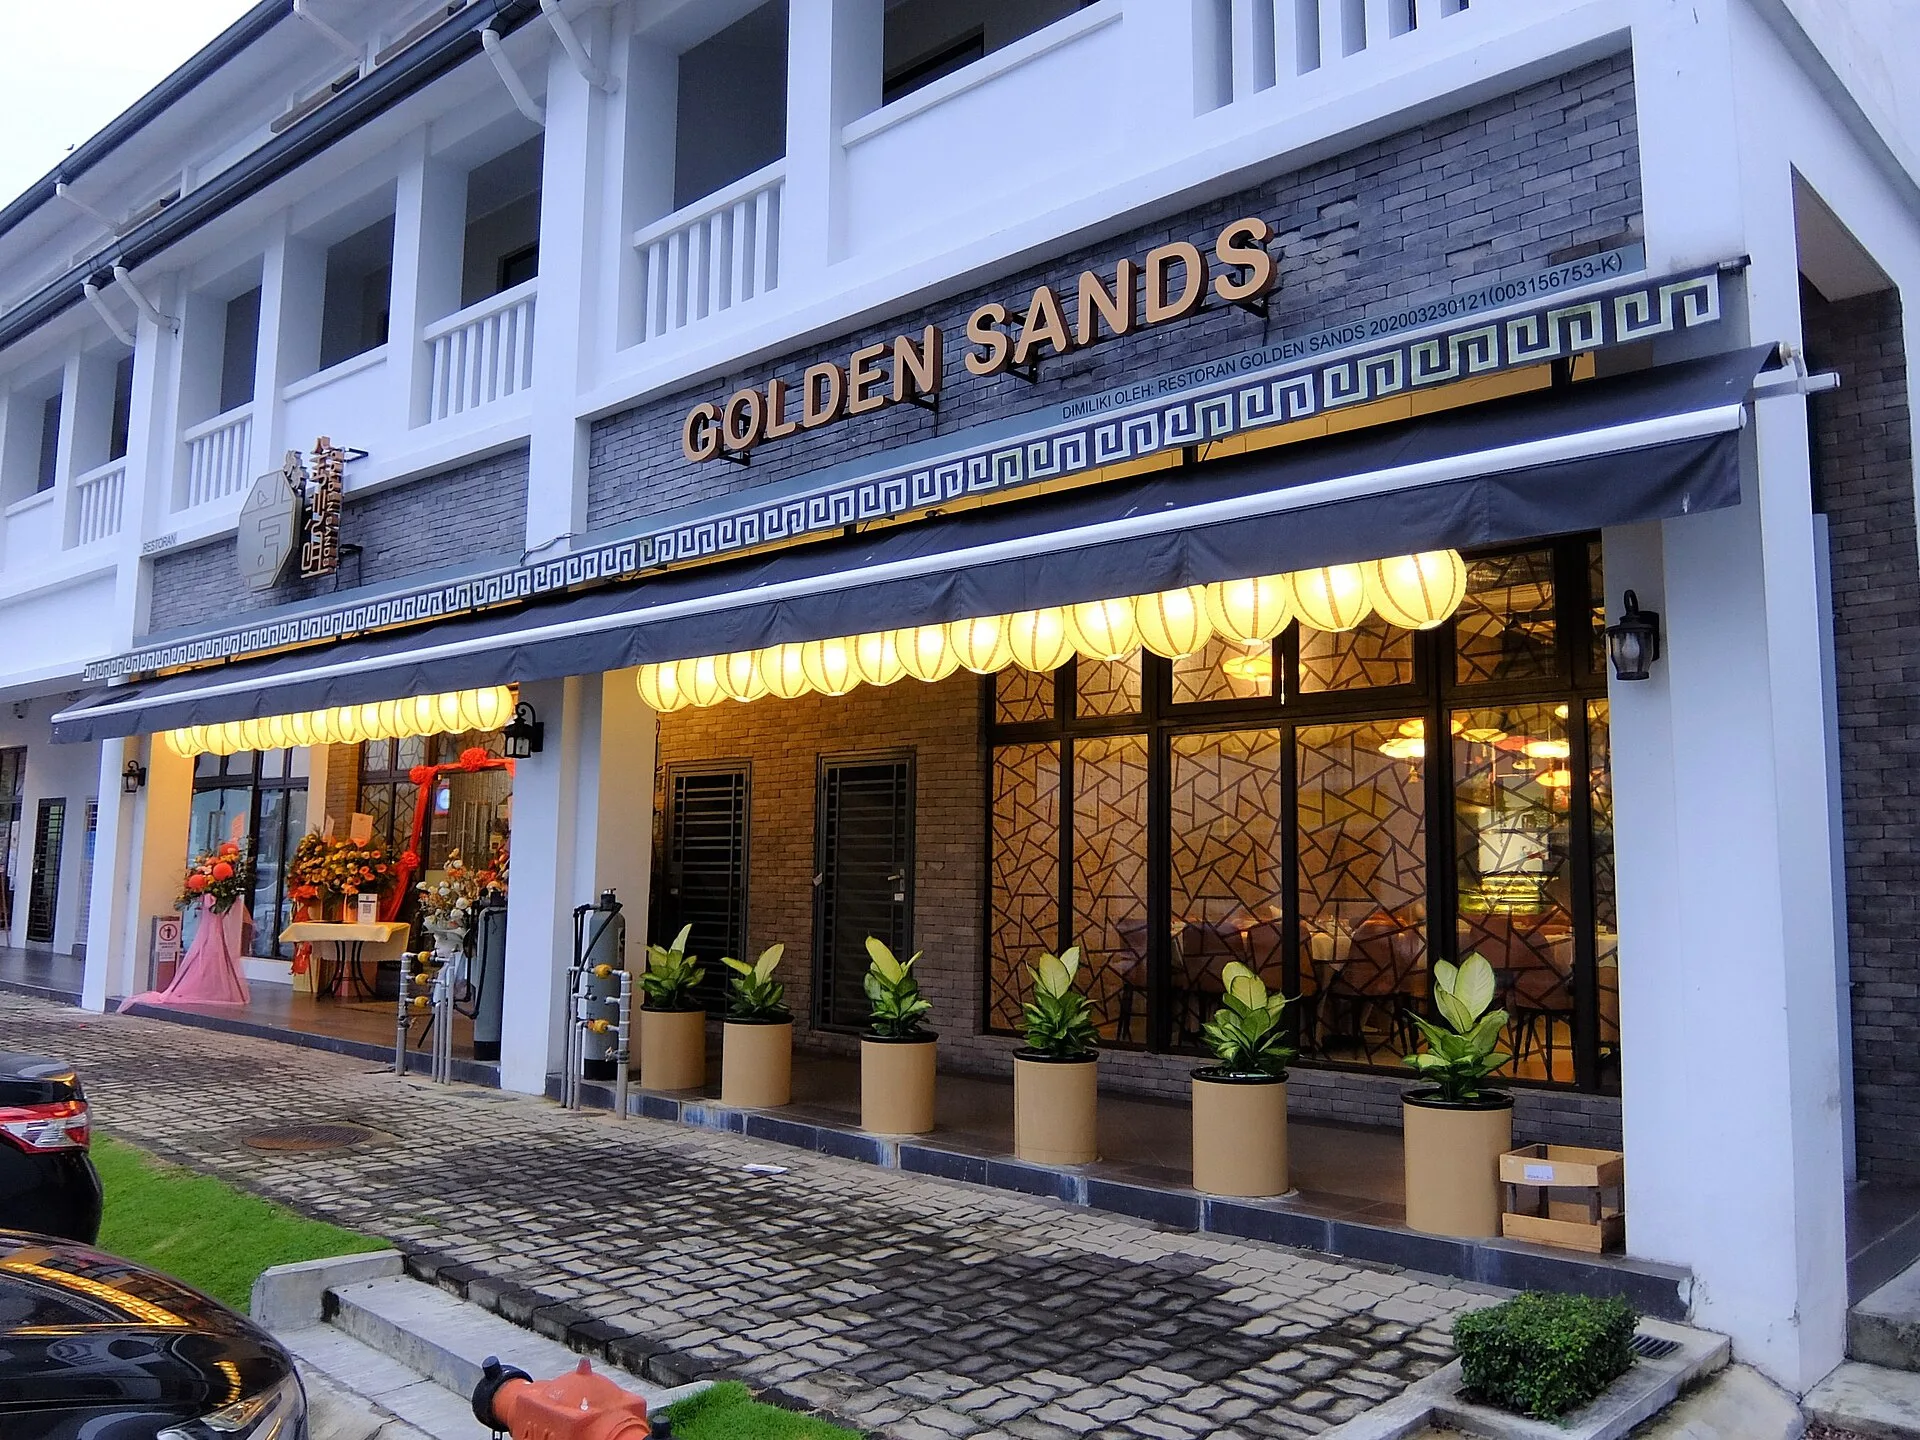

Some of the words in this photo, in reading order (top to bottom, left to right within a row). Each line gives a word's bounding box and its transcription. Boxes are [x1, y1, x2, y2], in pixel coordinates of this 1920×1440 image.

[682, 324, 942, 463] GOLDEN
[965, 217, 1276, 375] SANDS
[1062, 392, 1113, 419] DIMILIKI
[1115, 384, 1154, 404] OLEH:
[1158, 361, 1236, 393] RESTORAN
[1240, 340, 1304, 370] GOLDEN
[1309, 324, 1365, 351] SANDS
[1369, 252, 1623, 337] 202003230121(003156753-K)
[142, 532, 177, 553] RESTORAN
